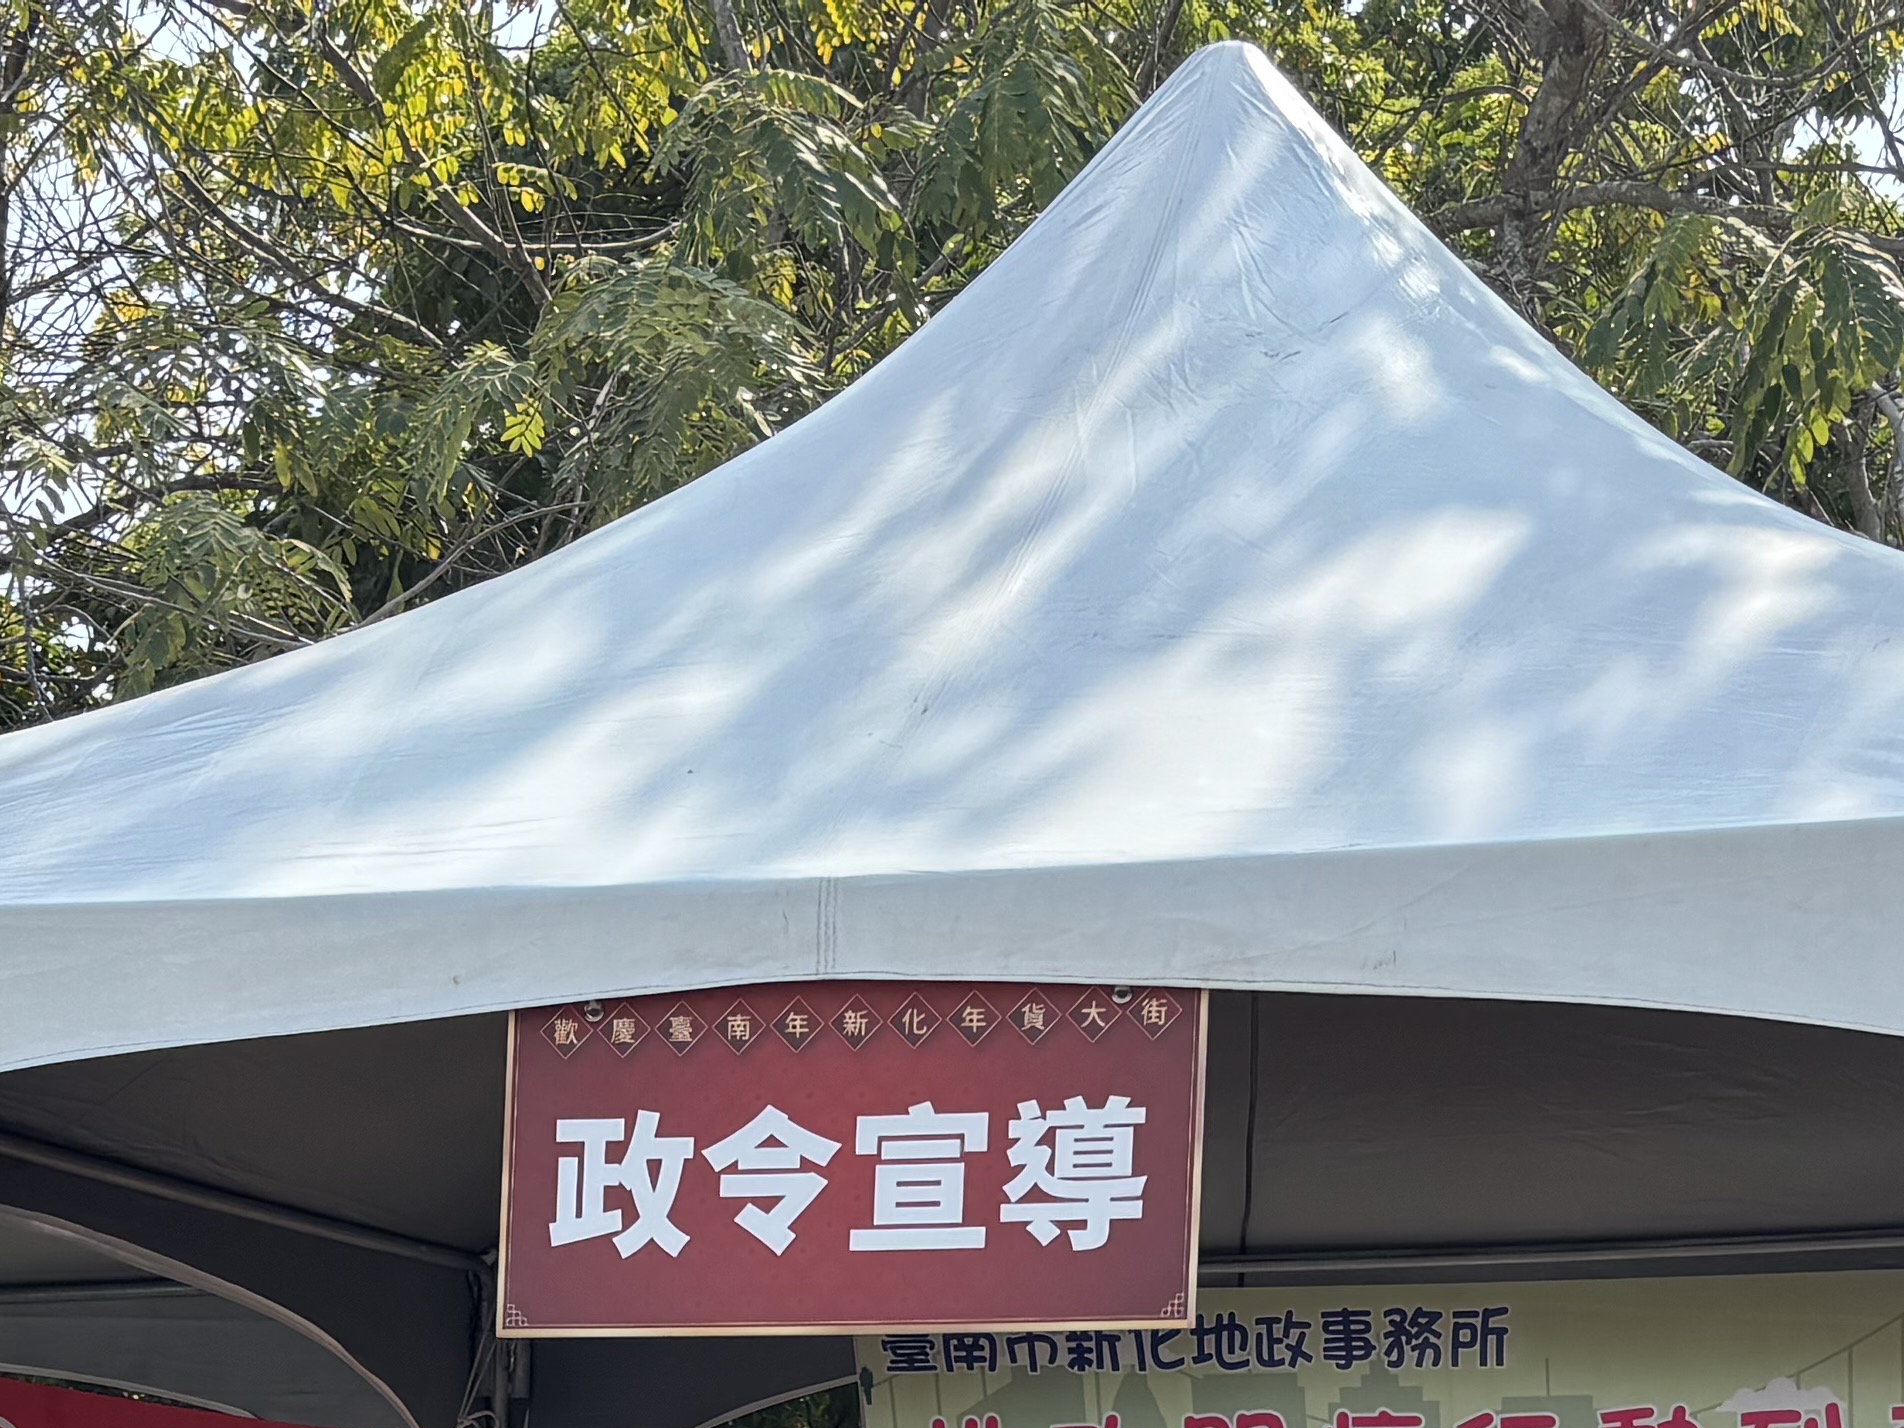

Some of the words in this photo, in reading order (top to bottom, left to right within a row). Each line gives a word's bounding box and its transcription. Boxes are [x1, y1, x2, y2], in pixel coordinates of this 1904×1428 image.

[553, 996, 1168, 1047] 歡慶臺南年新化年貨大街
[548, 1094, 1148, 1259] 政令宣導
[881, 1305, 1510, 1374] 臺南市新化地政事務所
